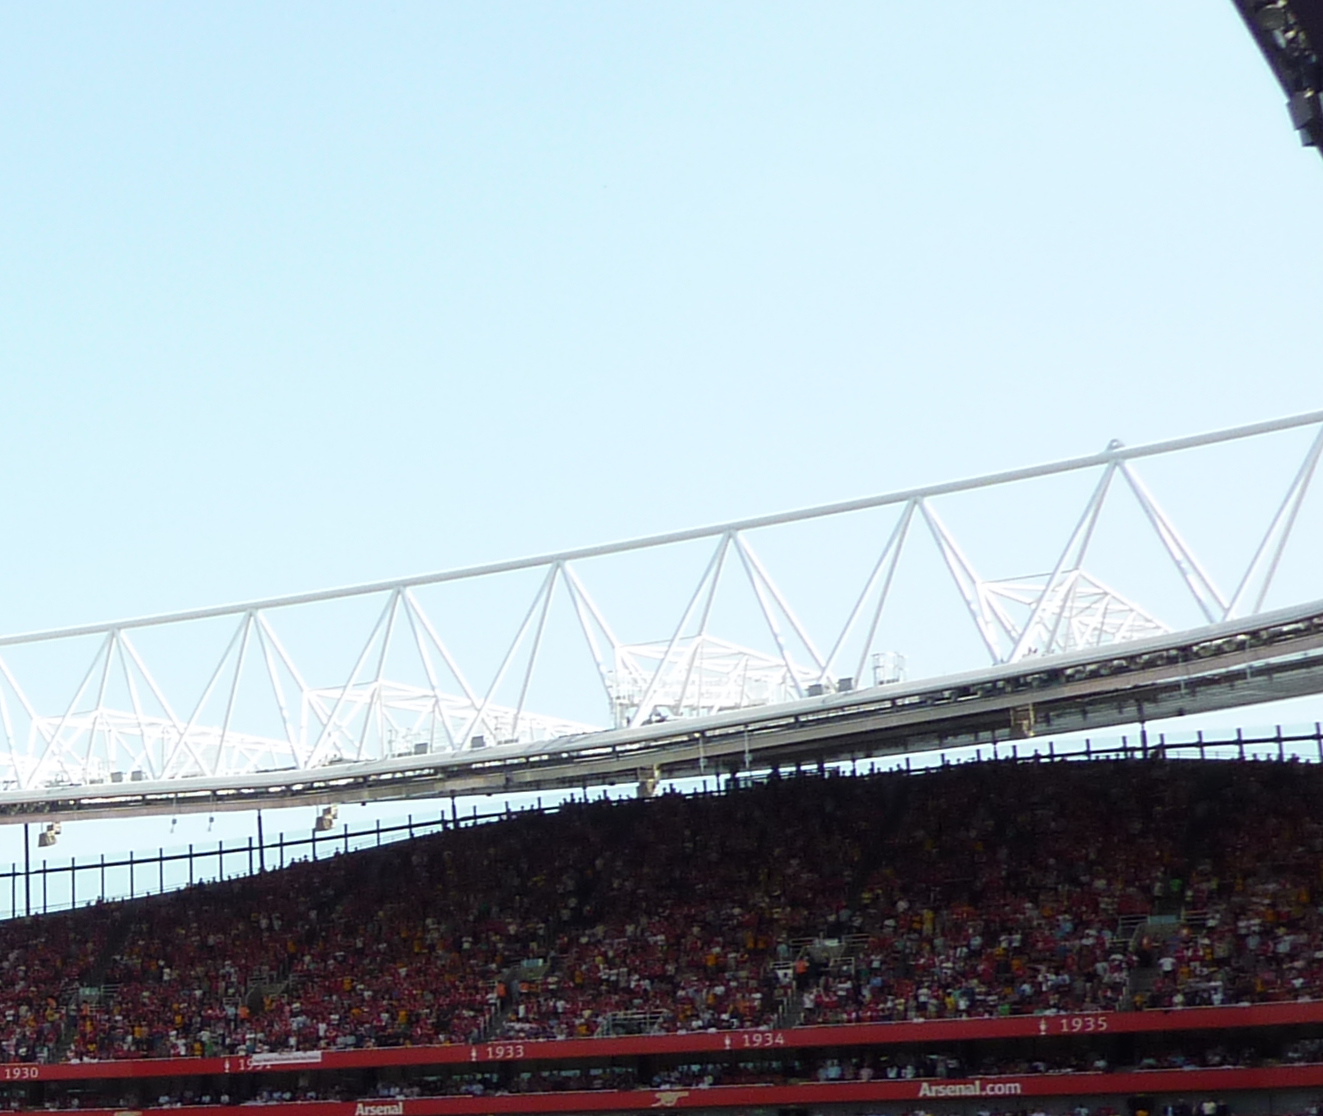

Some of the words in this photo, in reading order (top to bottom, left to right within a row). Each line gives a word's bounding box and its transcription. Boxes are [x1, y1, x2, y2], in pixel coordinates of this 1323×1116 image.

[1060, 1017, 1108, 1032] 1935
[743, 1033, 784, 1047] 1934
[487, 1045, 525, 1059] 1933
[5, 1067, 39, 1079] 1930
[919, 1081, 1021, 1097] Arsenal.com
[355, 1102, 404, 1116] Arsenal
